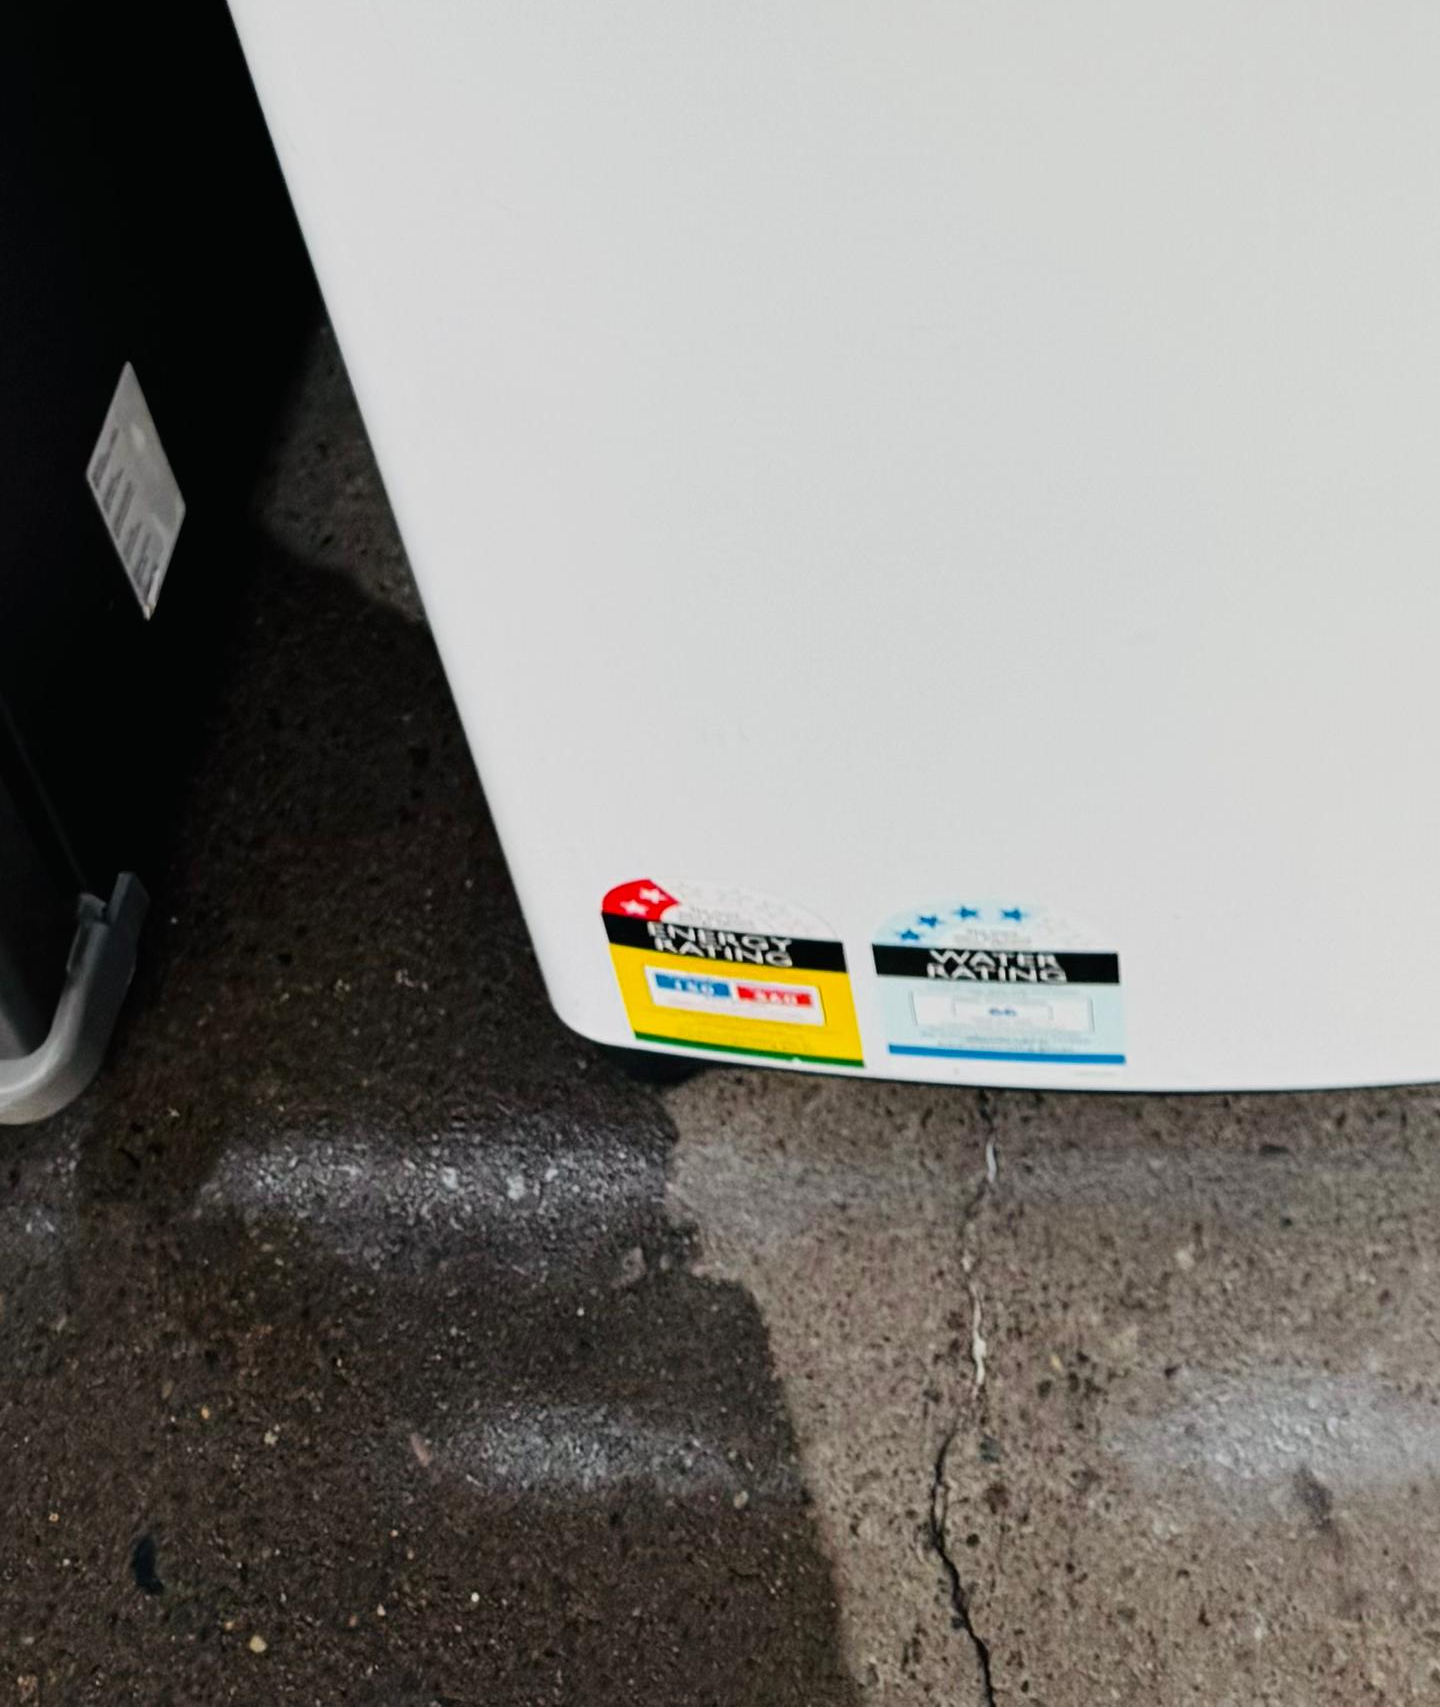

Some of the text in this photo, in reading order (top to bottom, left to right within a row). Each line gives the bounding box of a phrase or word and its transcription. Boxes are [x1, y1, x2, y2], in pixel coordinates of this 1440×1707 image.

[646, 920, 793, 953] ENERGY
[653, 935, 794, 969] RATING
[927, 949, 1060, 971] WATER
[925, 960, 1068, 986] RATING
